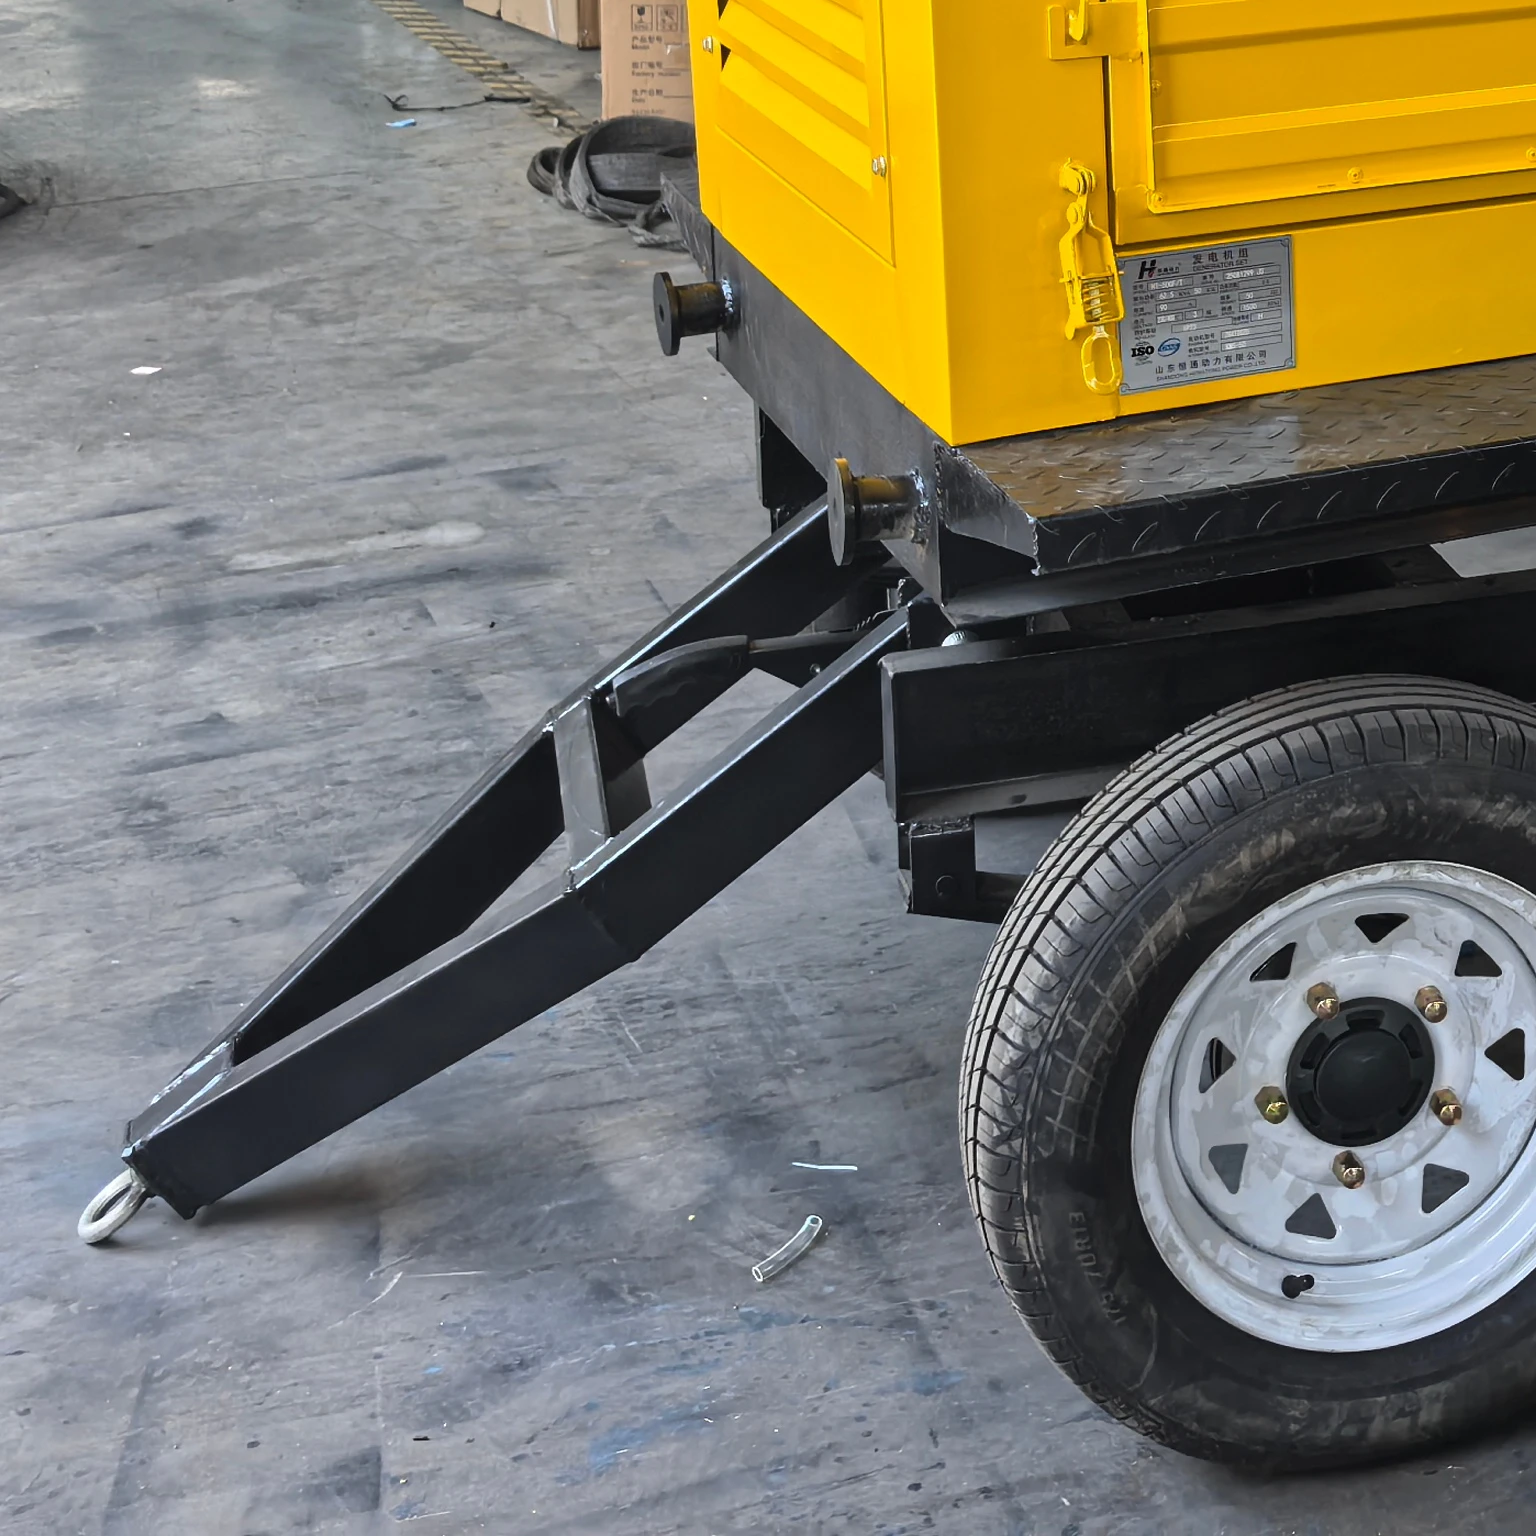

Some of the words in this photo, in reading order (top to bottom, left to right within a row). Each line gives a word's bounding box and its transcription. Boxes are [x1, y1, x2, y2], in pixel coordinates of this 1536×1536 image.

[1192, 247, 1249, 265] 发电机组
[1131, 345, 1155, 357] ISO
